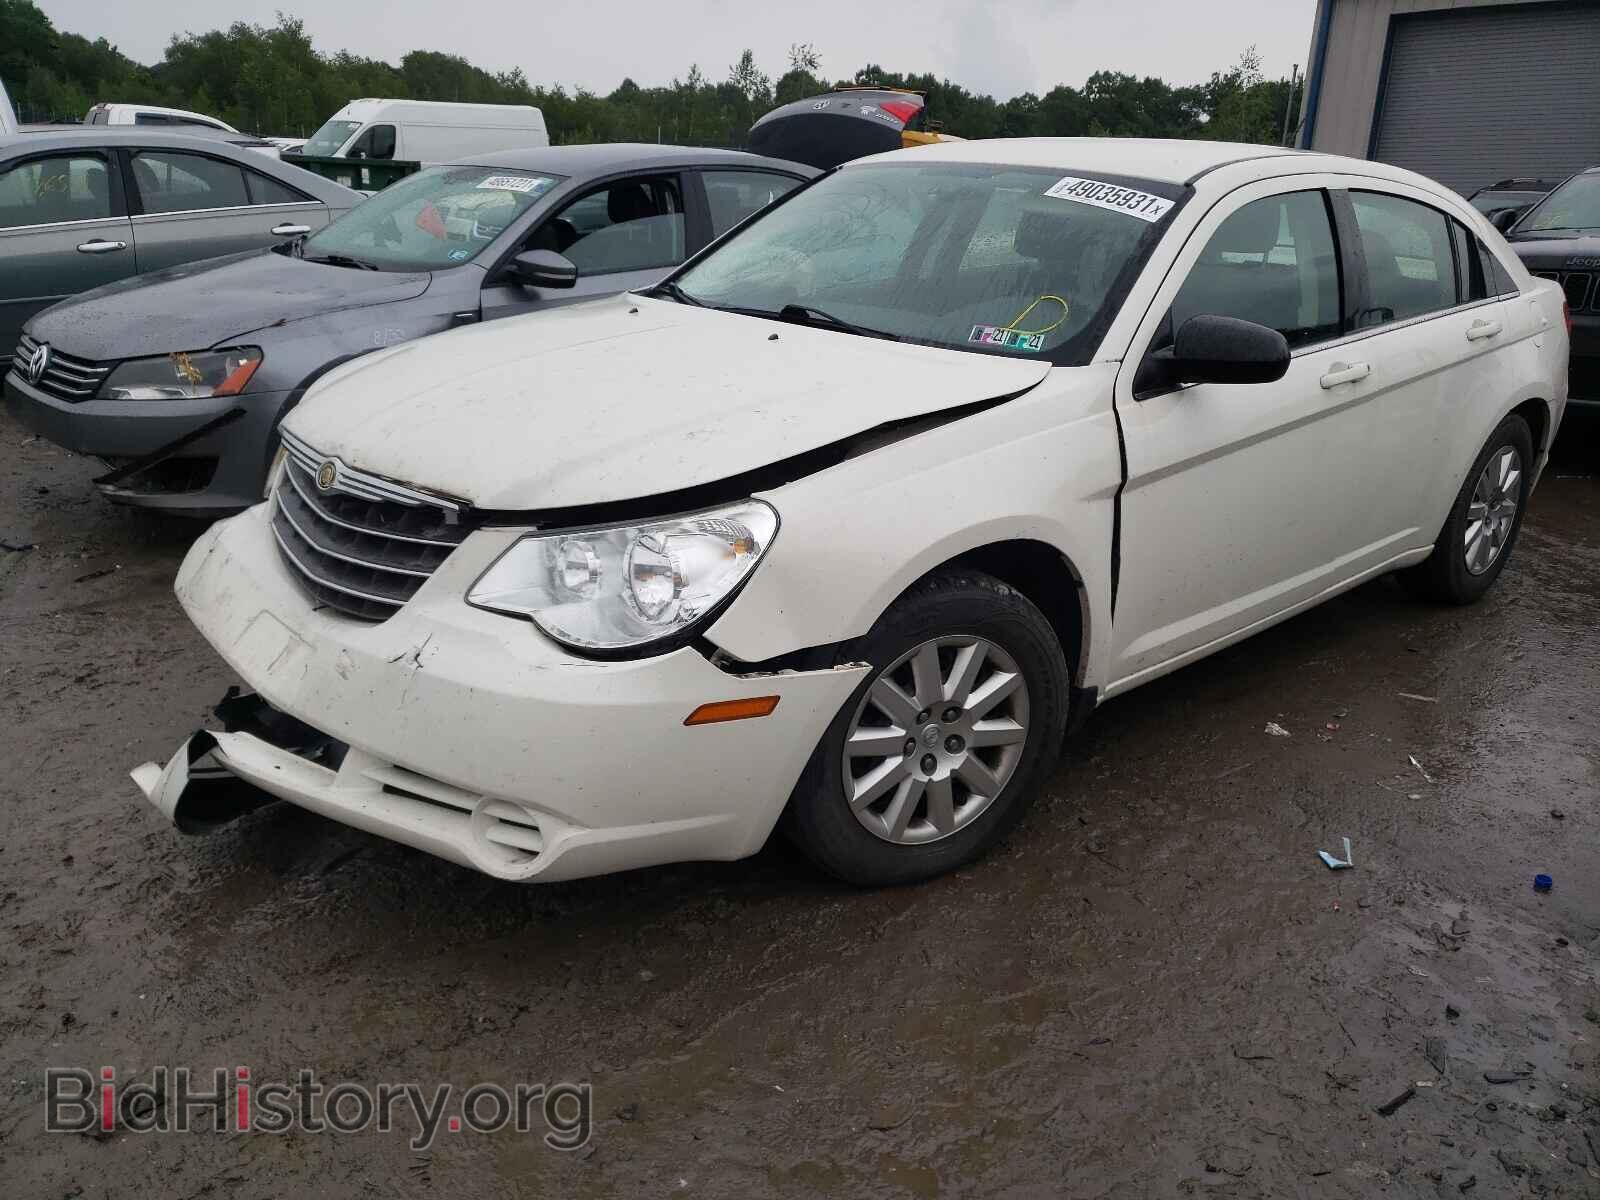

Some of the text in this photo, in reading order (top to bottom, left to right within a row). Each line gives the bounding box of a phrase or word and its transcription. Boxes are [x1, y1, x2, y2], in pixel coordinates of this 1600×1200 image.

[1066, 180, 1157, 213] 49035931
[992, 327, 1005, 342] 21
[1029, 334, 1041, 348] 21
